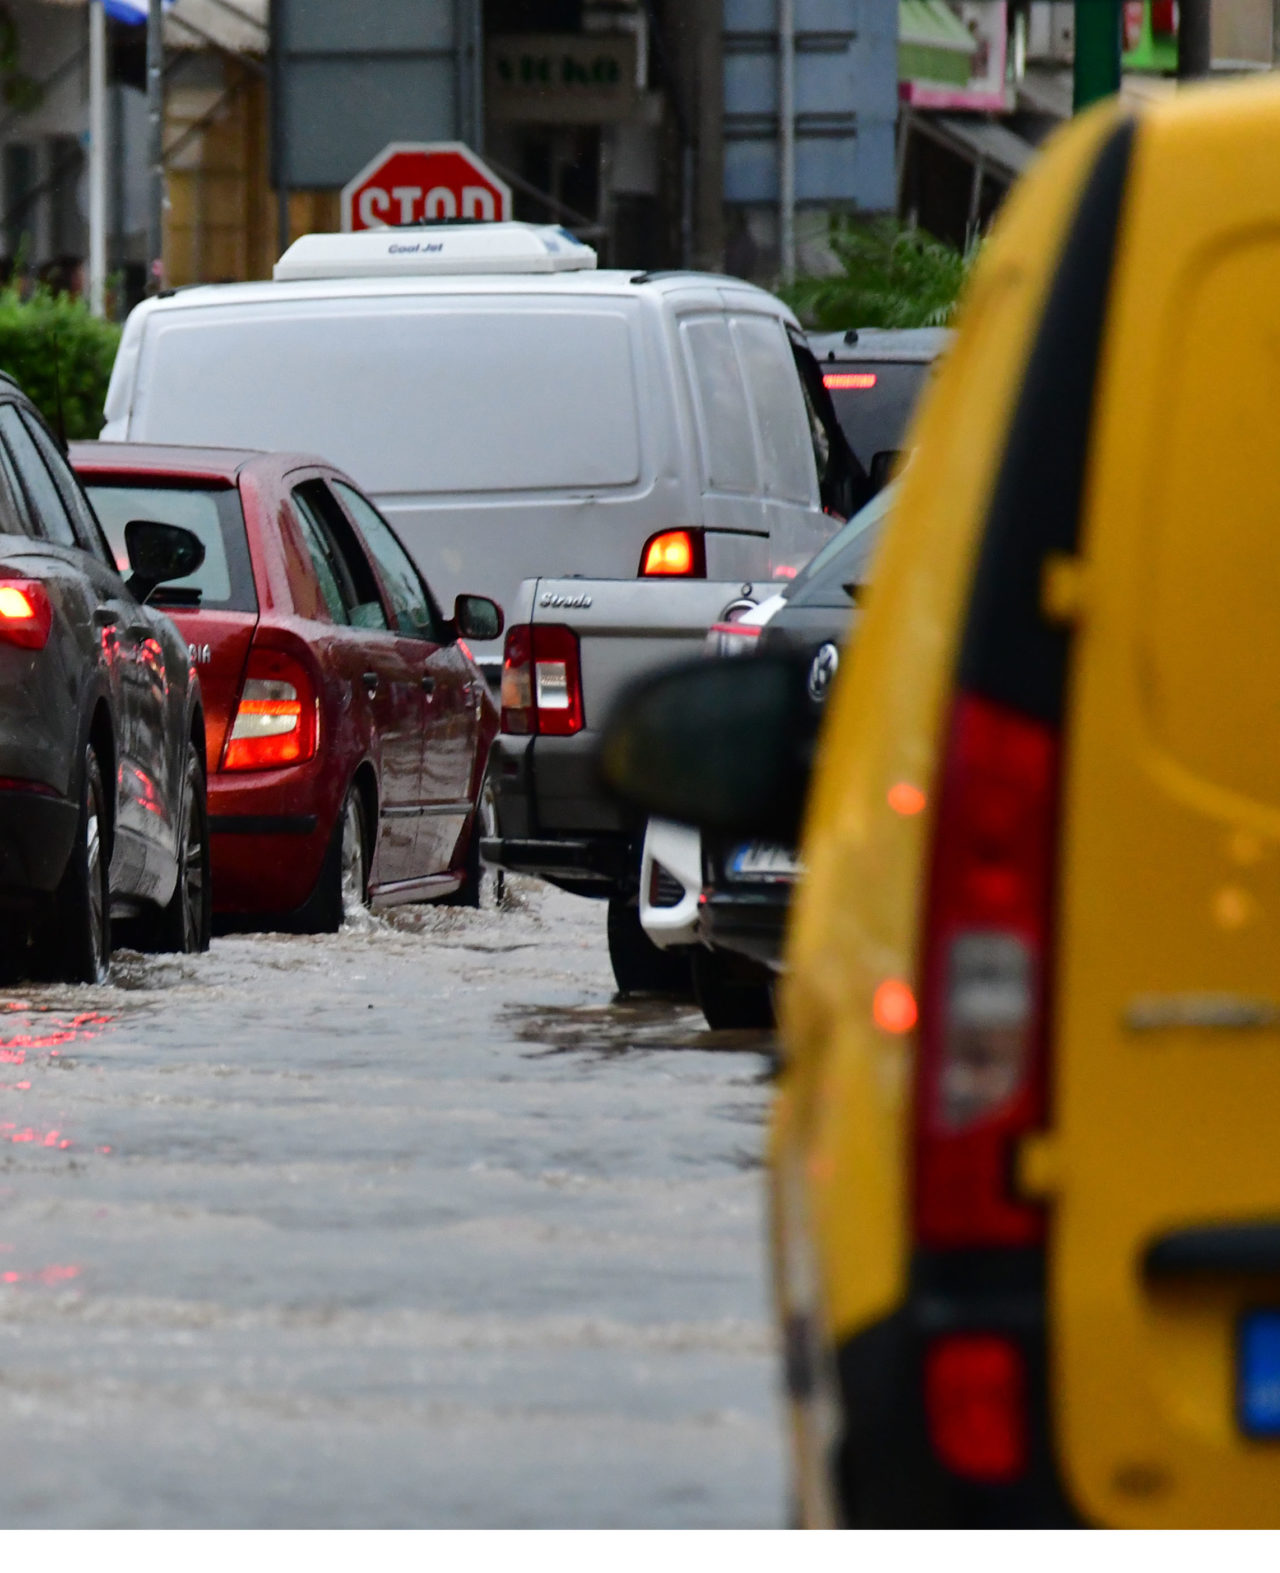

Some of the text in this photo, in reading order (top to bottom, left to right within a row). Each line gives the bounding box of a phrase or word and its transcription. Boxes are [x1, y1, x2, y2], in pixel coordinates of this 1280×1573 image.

[388, 243, 443, 254] Cool Jet
[540, 591, 592, 608] Strada
